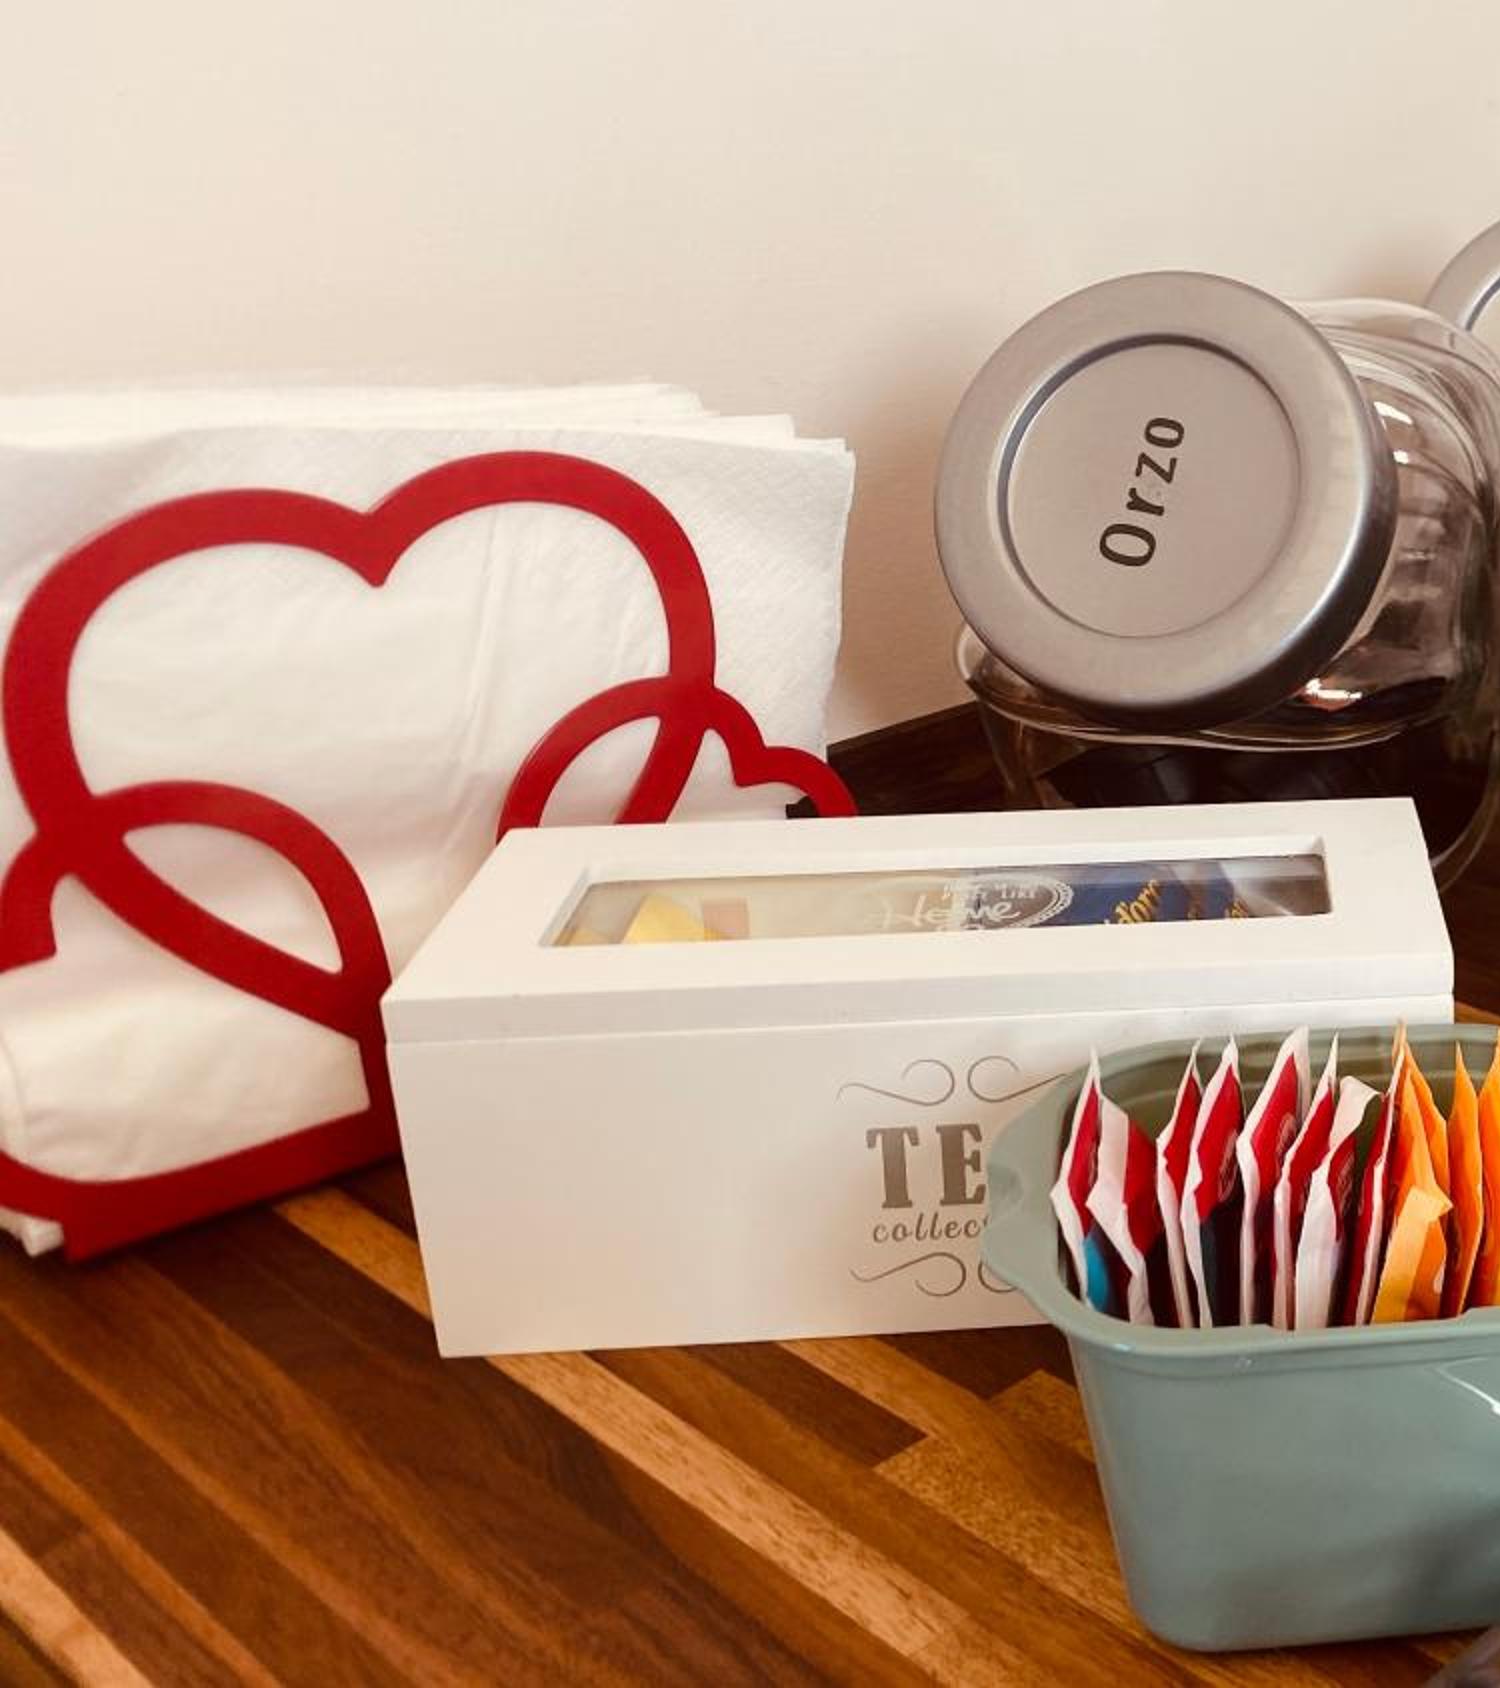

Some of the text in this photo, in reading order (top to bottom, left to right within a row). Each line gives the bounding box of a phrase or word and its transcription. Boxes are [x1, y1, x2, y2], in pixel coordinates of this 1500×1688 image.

[1099, 417, 1185, 567] Orzo
[865, 1123, 987, 1209] TE
[872, 1211, 990, 1243] collec
